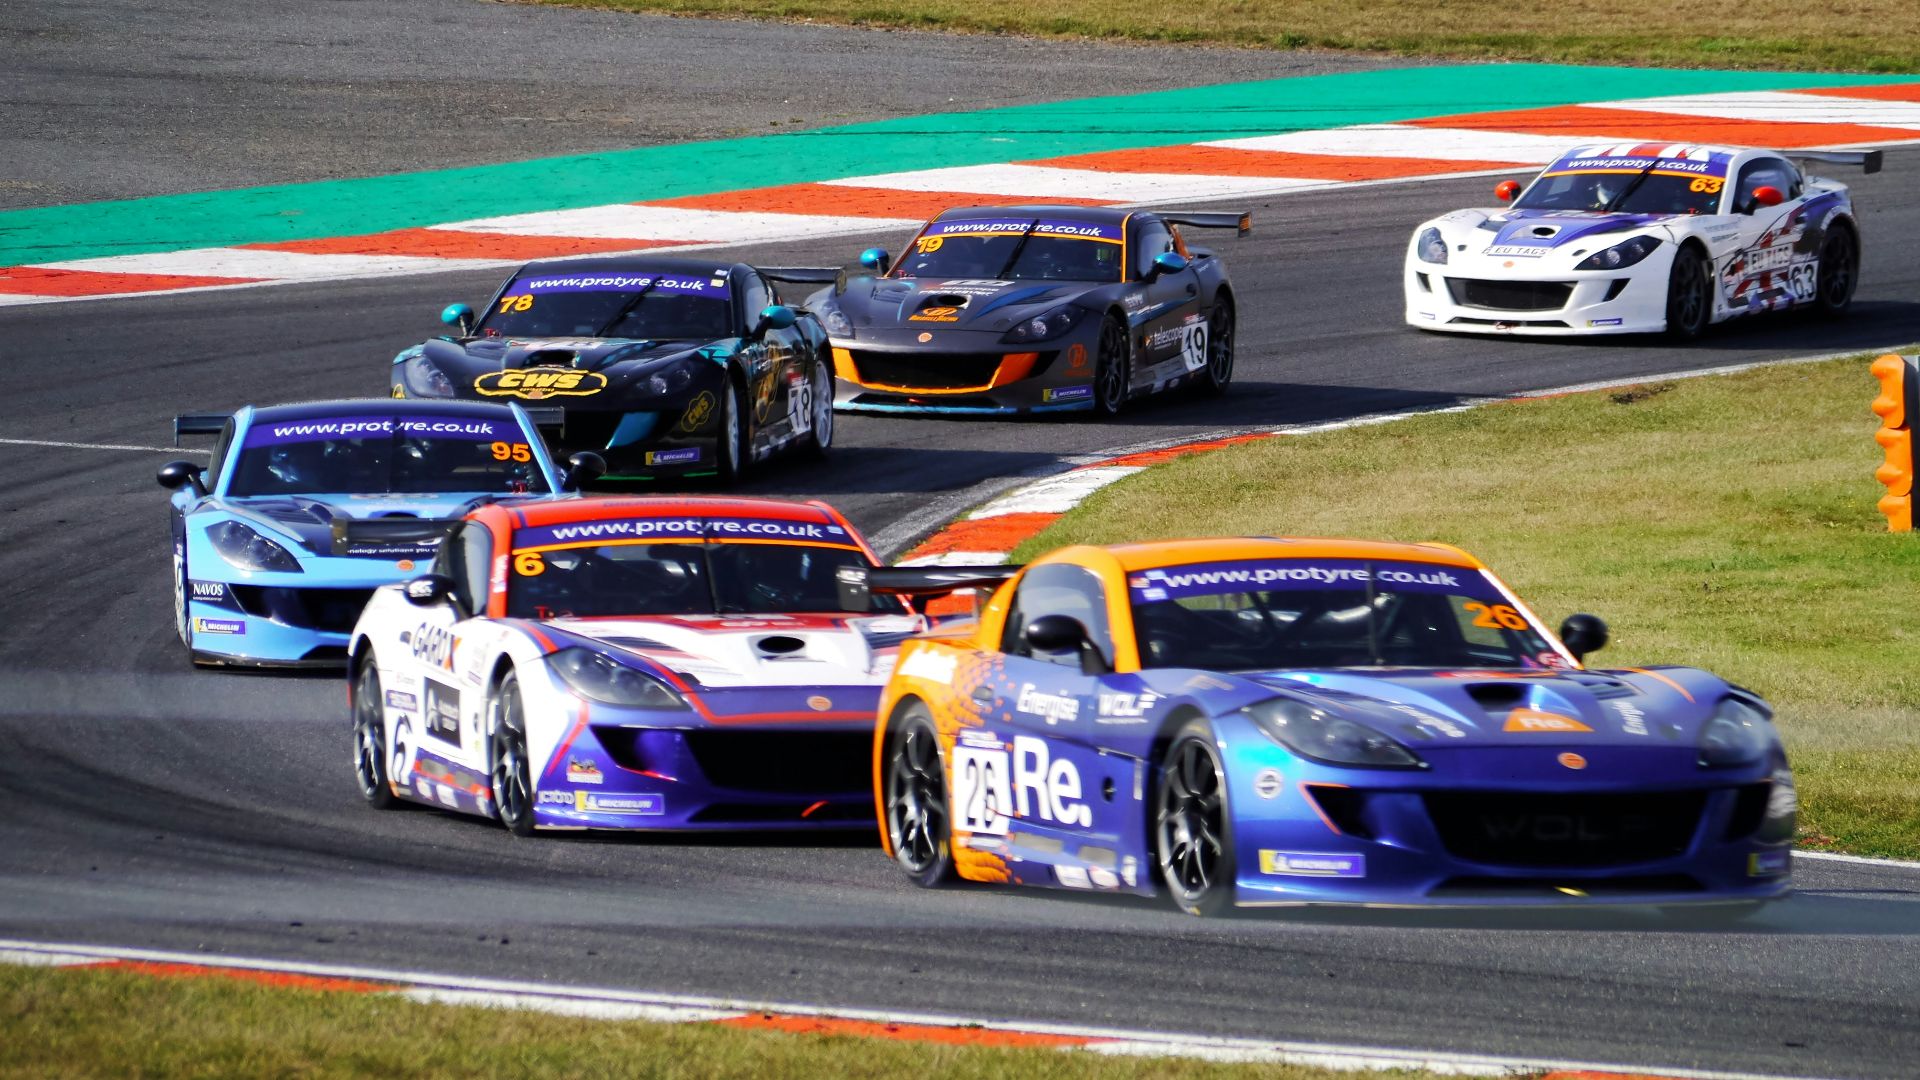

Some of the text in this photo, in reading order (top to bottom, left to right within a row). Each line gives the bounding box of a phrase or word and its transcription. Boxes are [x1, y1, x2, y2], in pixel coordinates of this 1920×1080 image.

[1690, 178, 1721, 193] 63
[917, 237, 944, 253] 19
[1516, 247, 1547, 255] TAGS
[1791, 264, 1815, 299] 63
[500, 294, 534, 313] 78
[1184, 326, 1206, 364] 19
[497, 373, 585, 389] CWS
[790, 387, 810, 429] 78
[490, 441, 531, 462] 95
[551, 520, 823, 540] www.protyre.co.uk
[514, 553, 546, 577] 6
[193, 583, 223, 596] NAVOS
[1463, 601, 1529, 631] 26
[1013, 734, 1093, 828] Re.
[966, 757, 999, 829] 26
